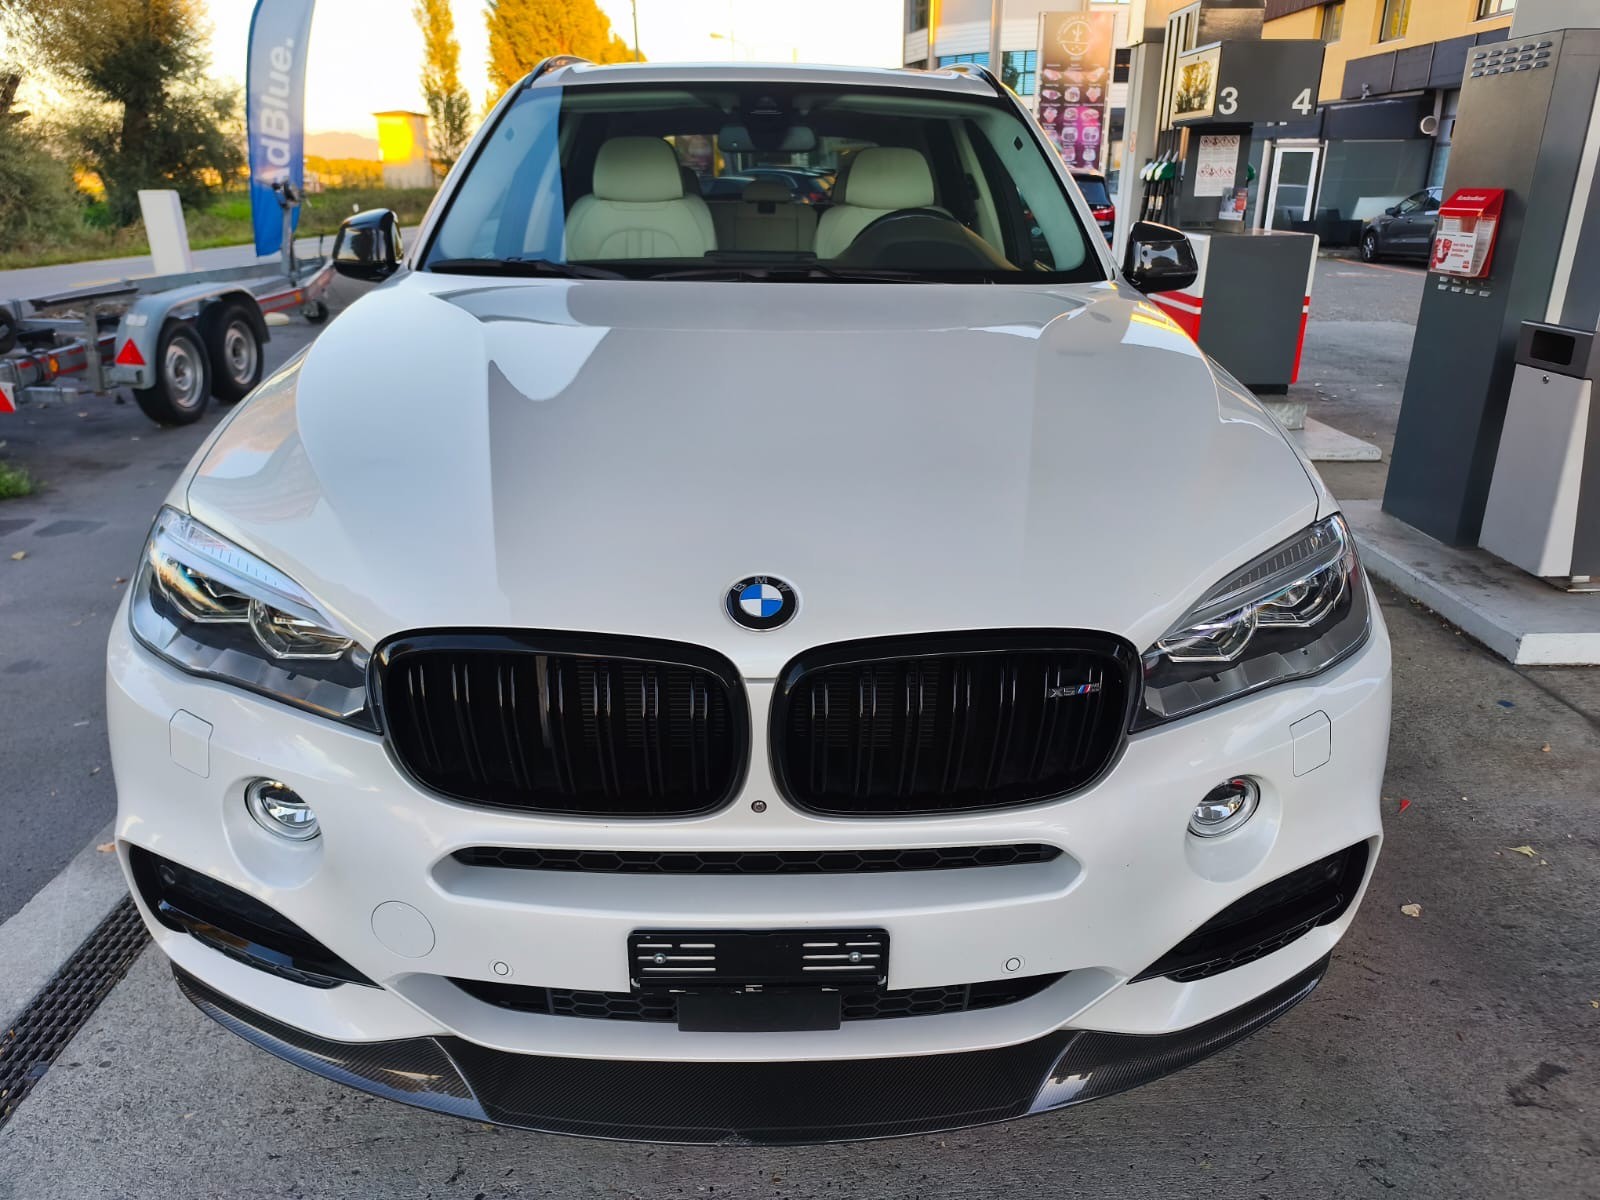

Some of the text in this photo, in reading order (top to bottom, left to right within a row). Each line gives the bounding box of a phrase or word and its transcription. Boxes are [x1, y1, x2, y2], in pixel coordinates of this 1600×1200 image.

[1218, 86, 1239, 115] 3
[1291, 88, 1312, 115] 4
[732, 575, 790, 592] BMW
